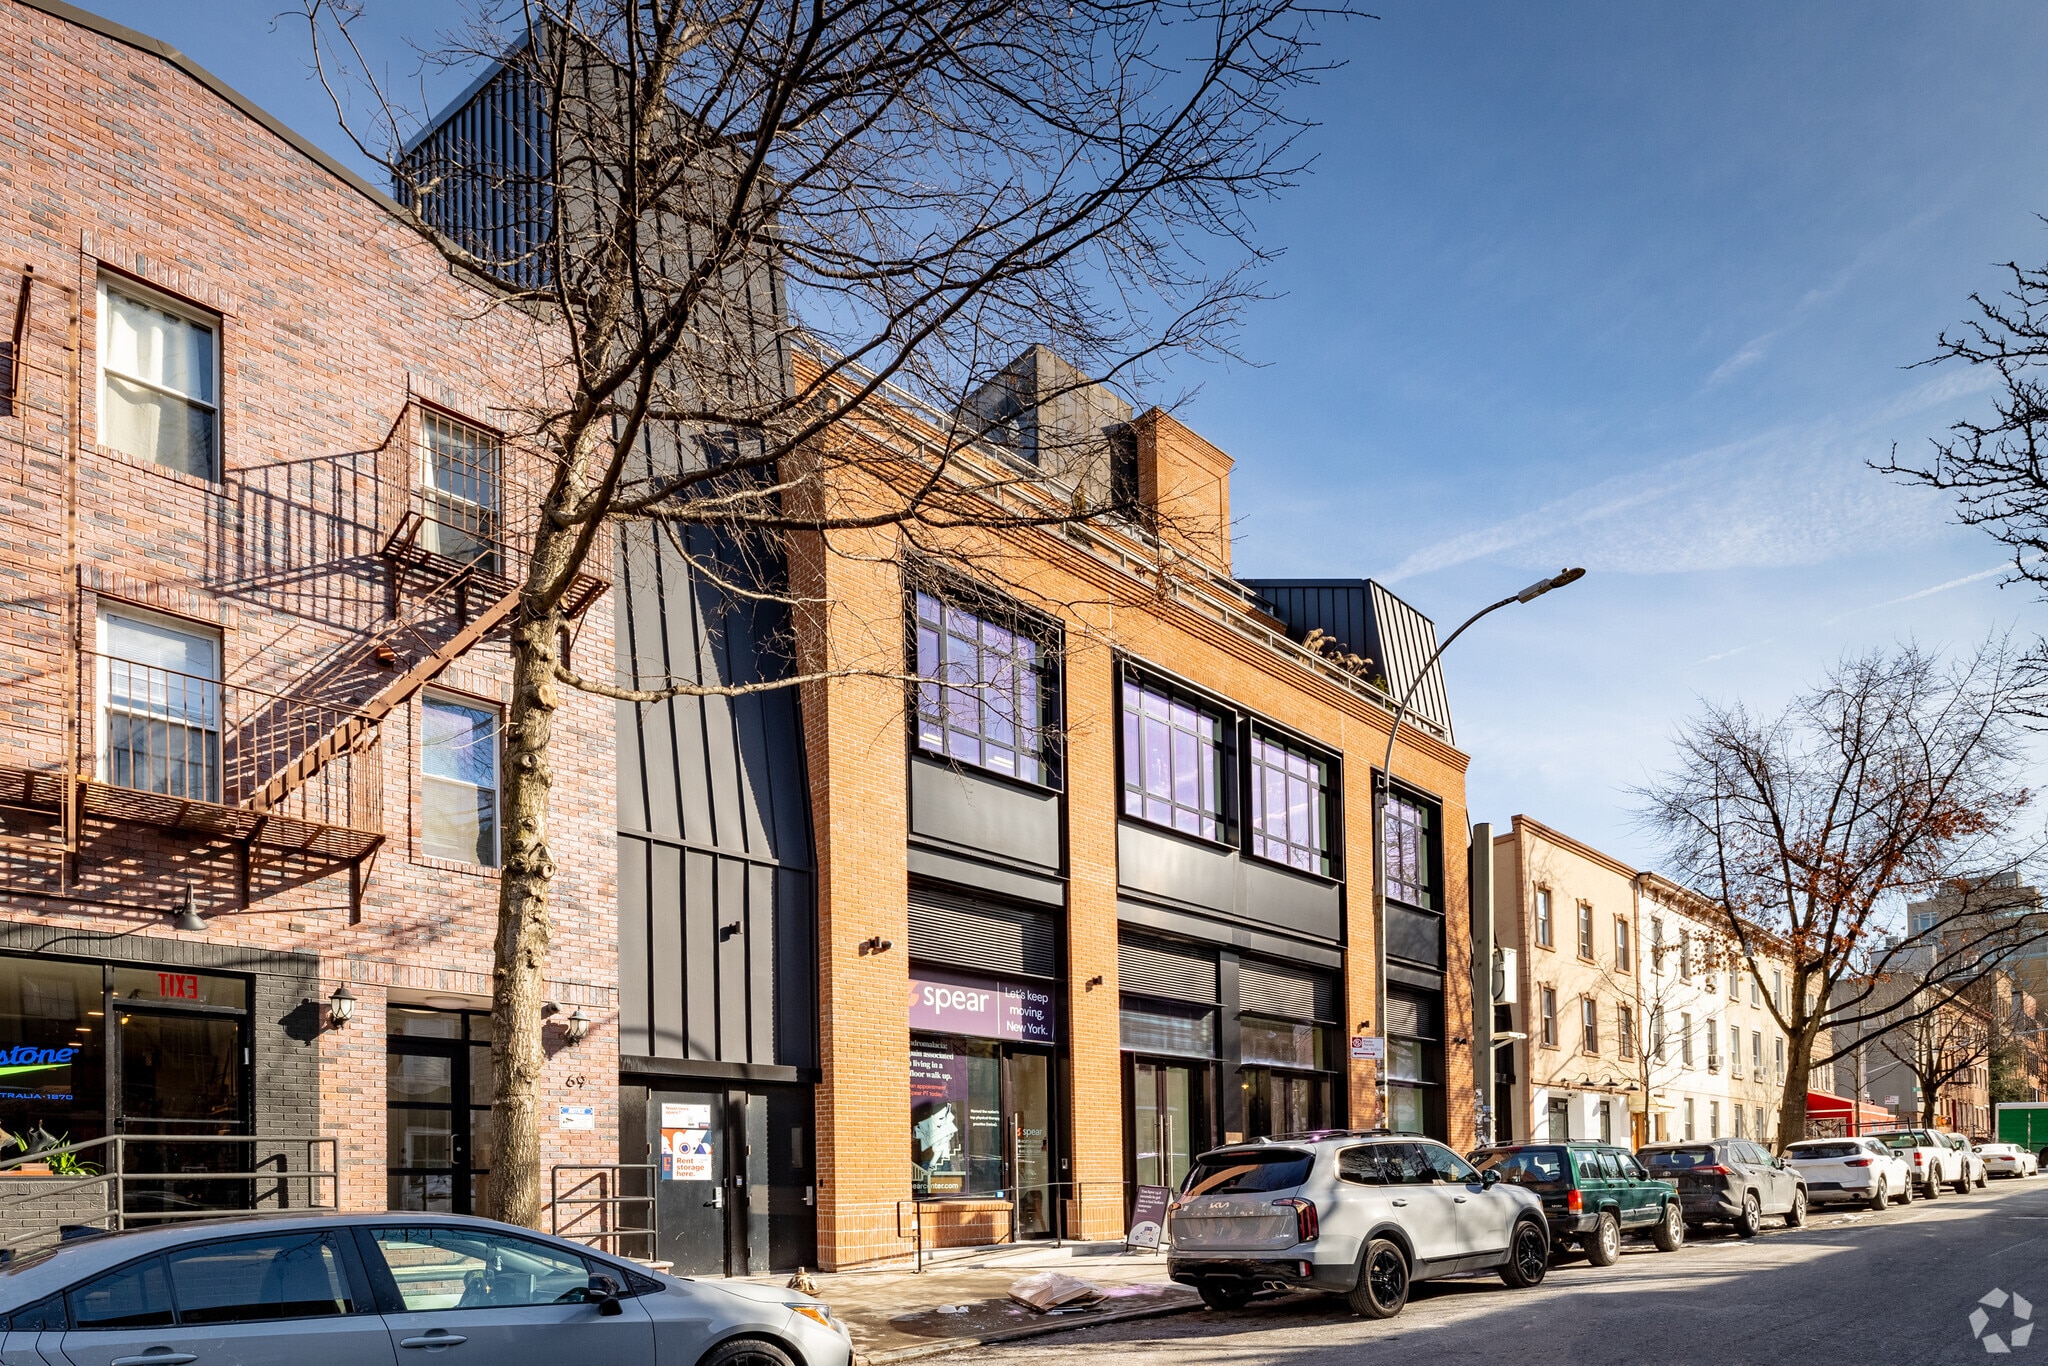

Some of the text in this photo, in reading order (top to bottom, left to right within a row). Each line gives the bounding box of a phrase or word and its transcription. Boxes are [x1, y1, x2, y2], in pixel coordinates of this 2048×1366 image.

[923, 986, 990, 1014] spear
[1005, 987, 1048, 1005] Let's keep
[1006, 1020, 1048, 1036] New York.
[923, 1052, 954, 1060] associated
[912, 1060, 931, 1070] living
[1023, 1128, 1042, 1137] spear
